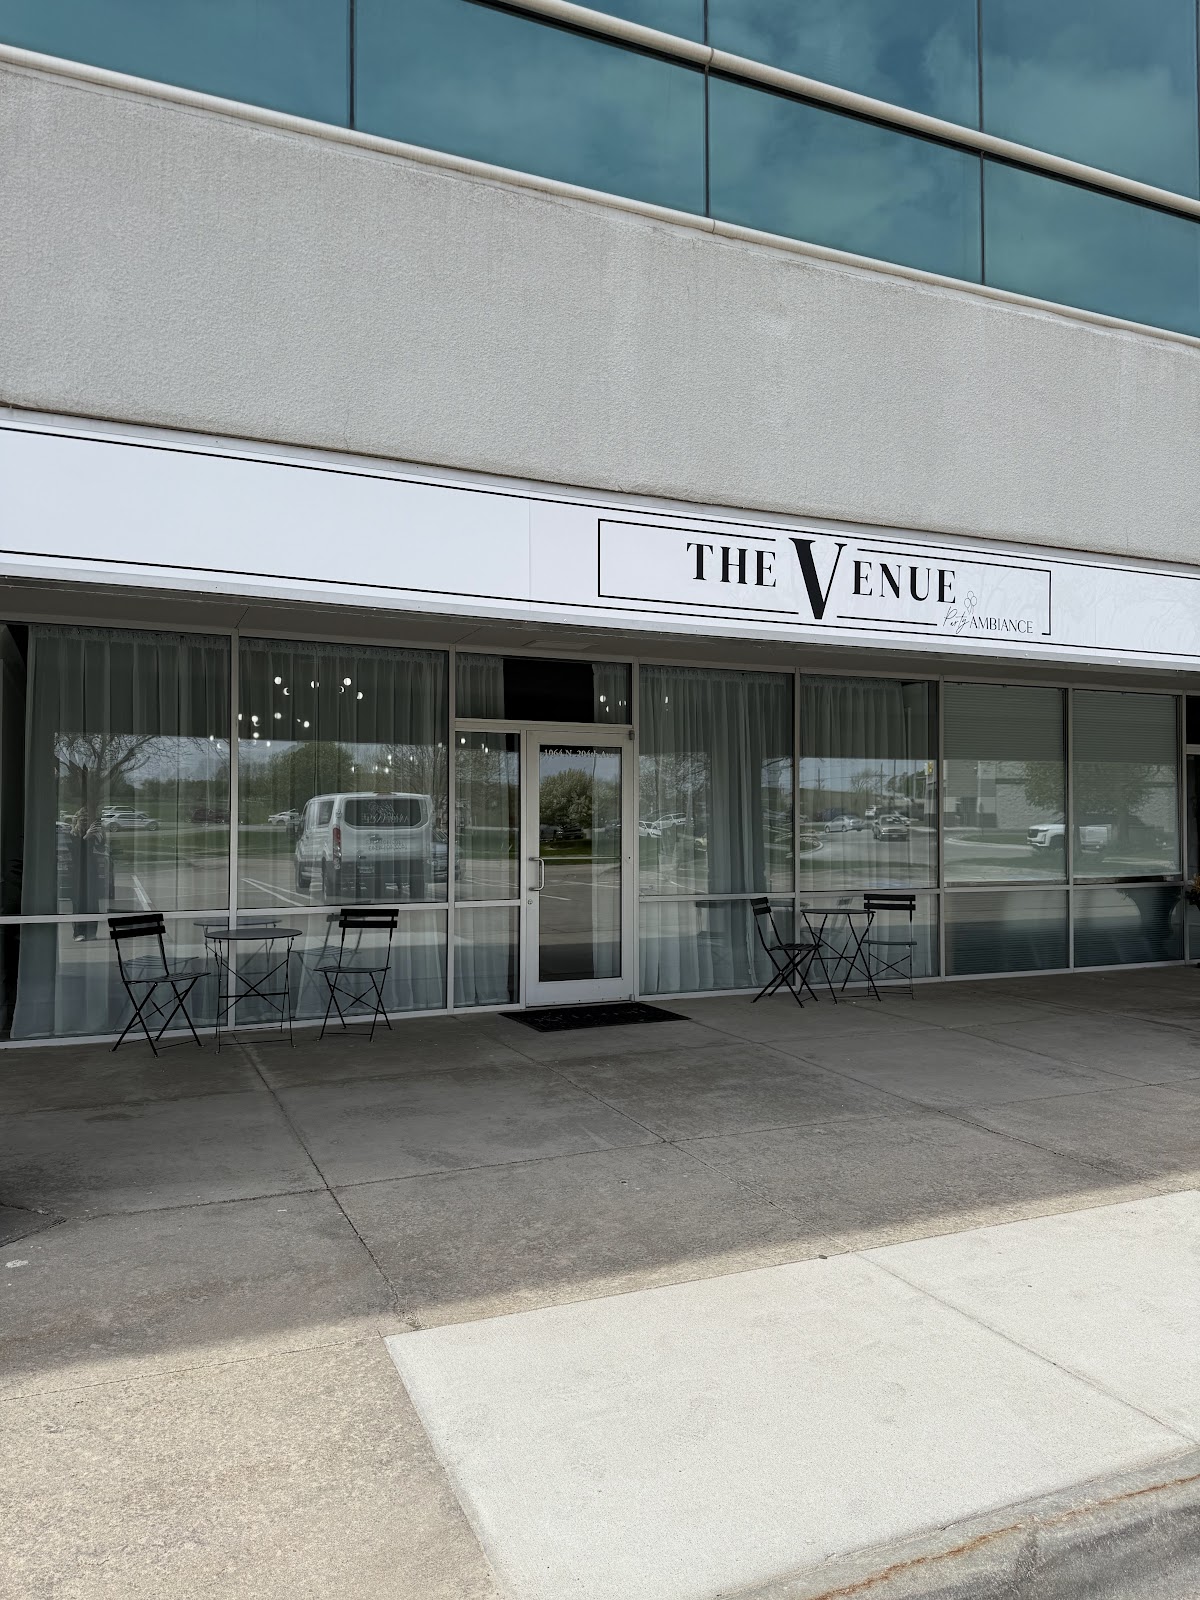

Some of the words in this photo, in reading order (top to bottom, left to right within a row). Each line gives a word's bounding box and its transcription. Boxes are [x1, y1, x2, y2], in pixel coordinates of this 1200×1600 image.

[686, 542, 777, 588] THE
[788, 537, 957, 620] VENUE
[942, 606, 969, 634] Party
[969, 615, 1034, 634] AMBIANCE
